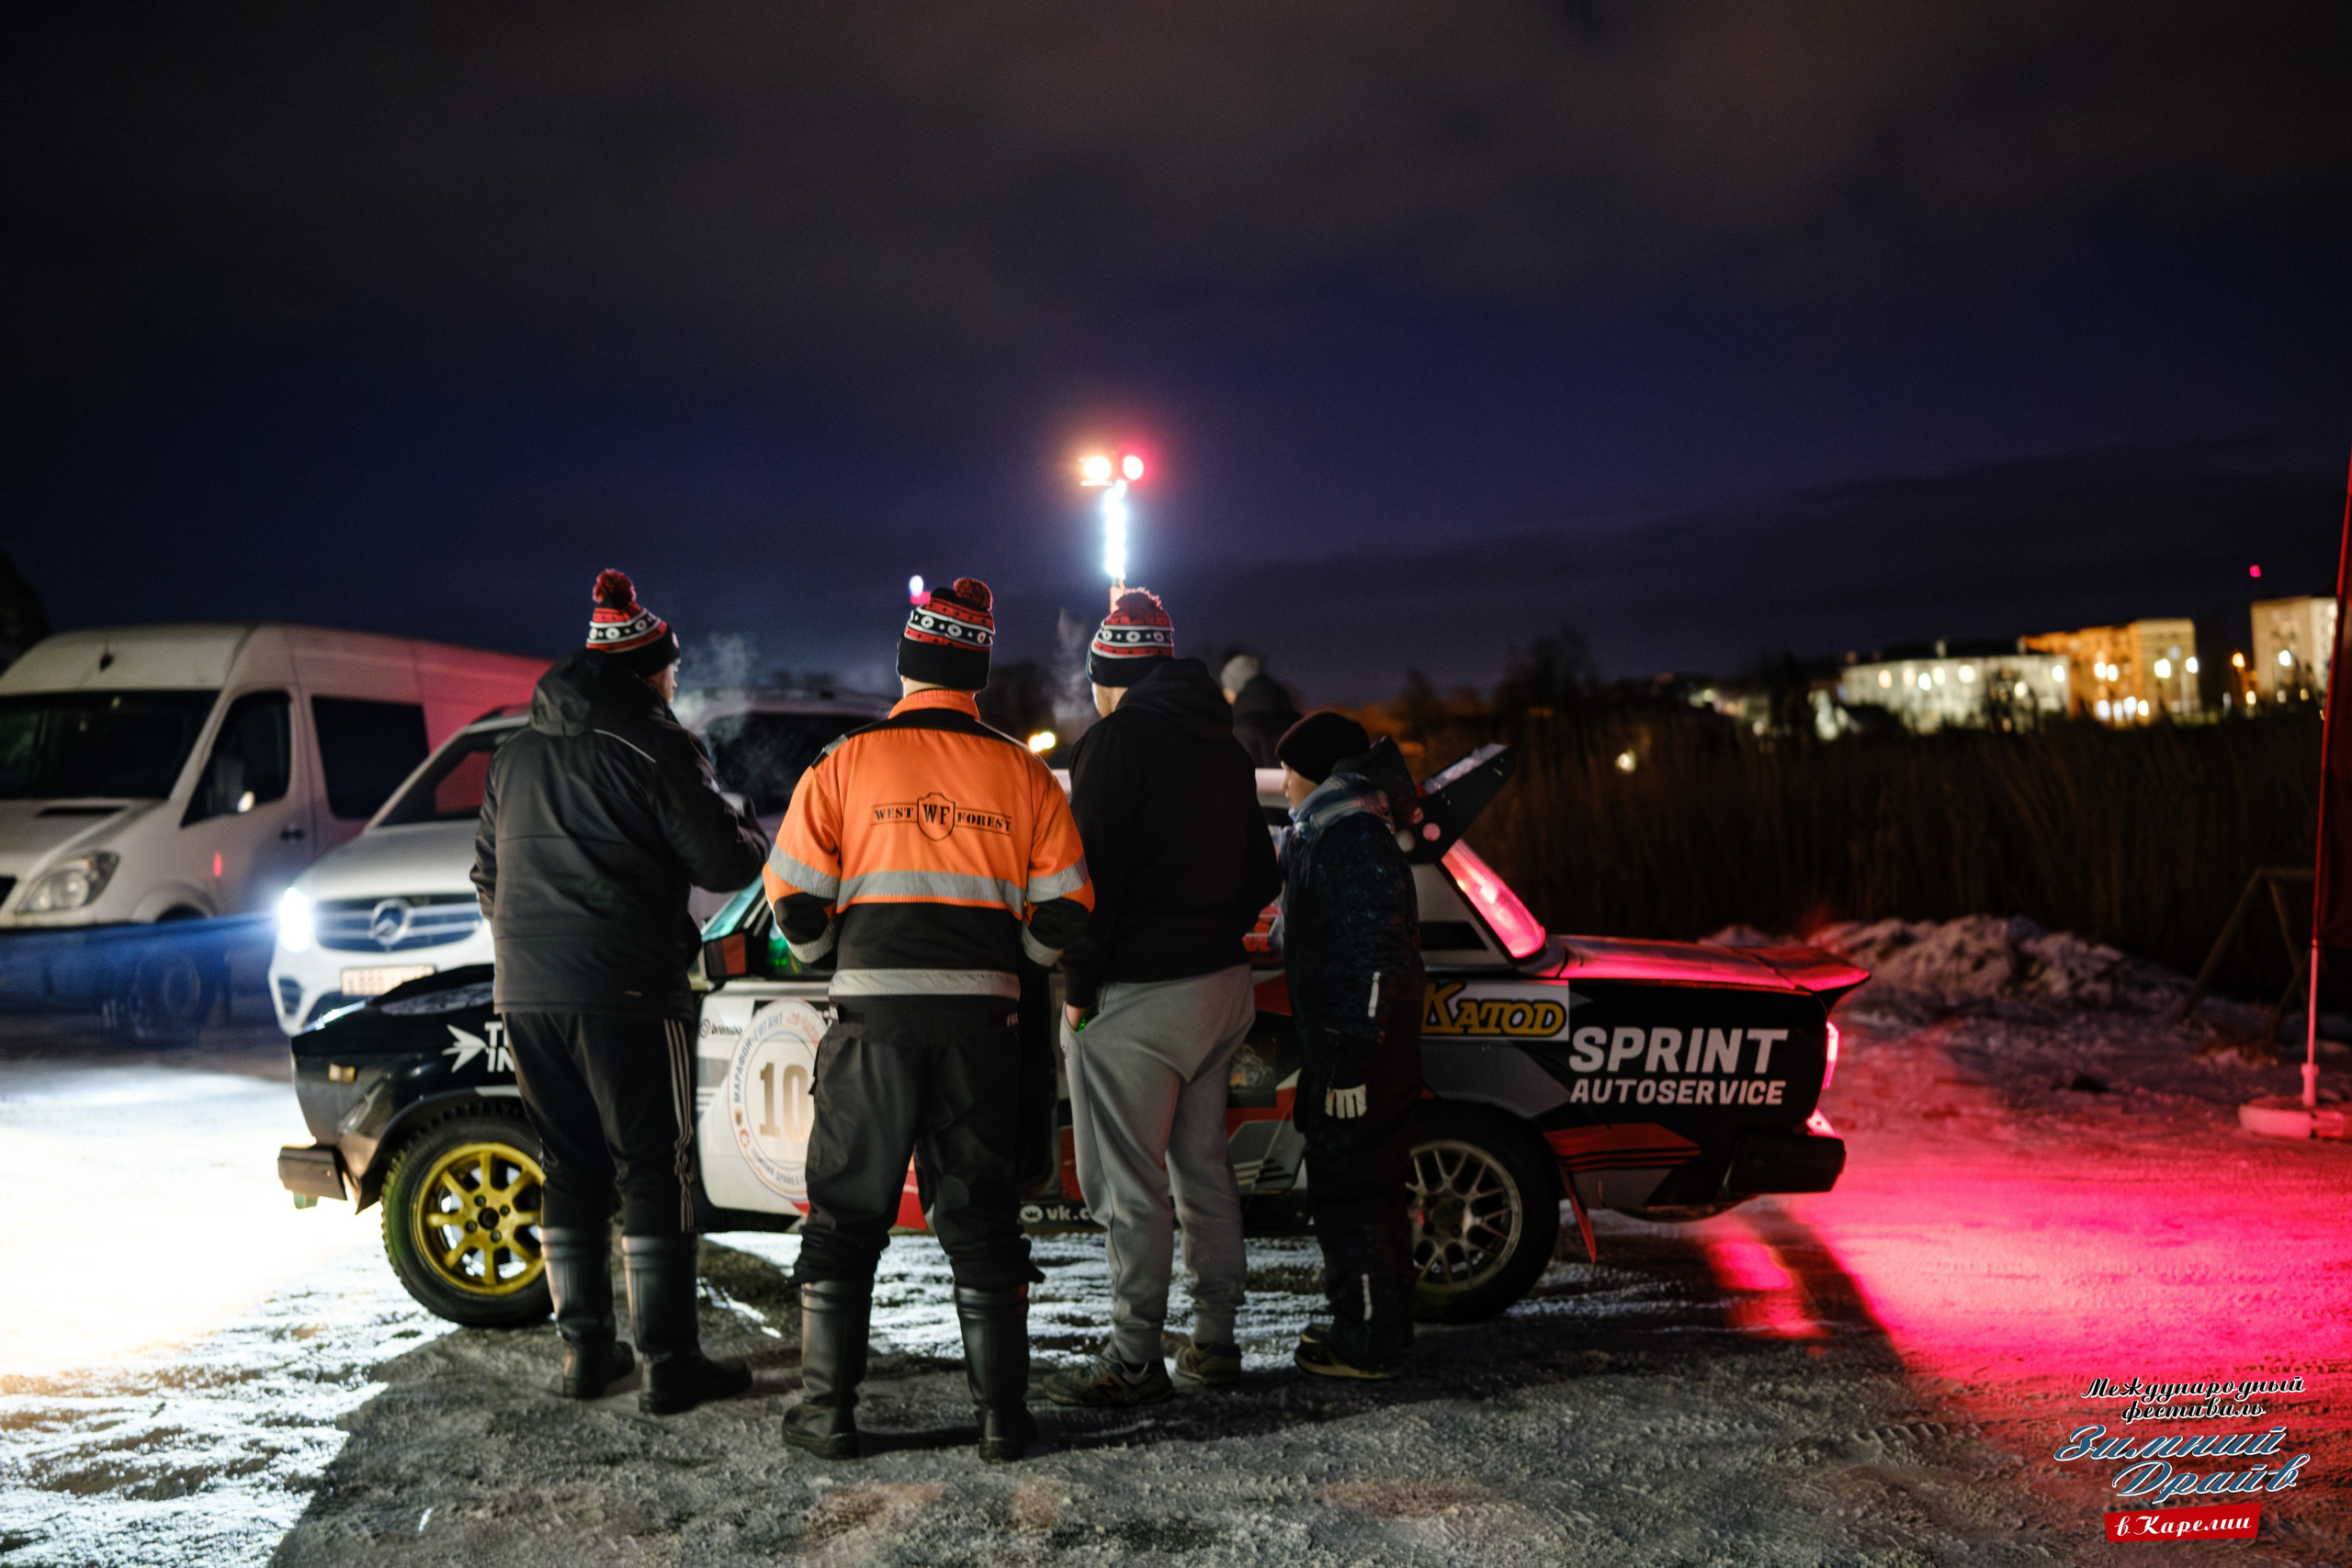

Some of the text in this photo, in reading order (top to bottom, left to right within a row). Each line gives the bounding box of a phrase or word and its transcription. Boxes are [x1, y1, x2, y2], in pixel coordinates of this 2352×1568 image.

[874, 804, 1012, 831] WEST WF FOREST
[1420, 980, 1568, 1037] KATOD
[1569, 1026, 1790, 1074] SPRINT
[1569, 1078, 1787, 1105] AUTOSERVICE
